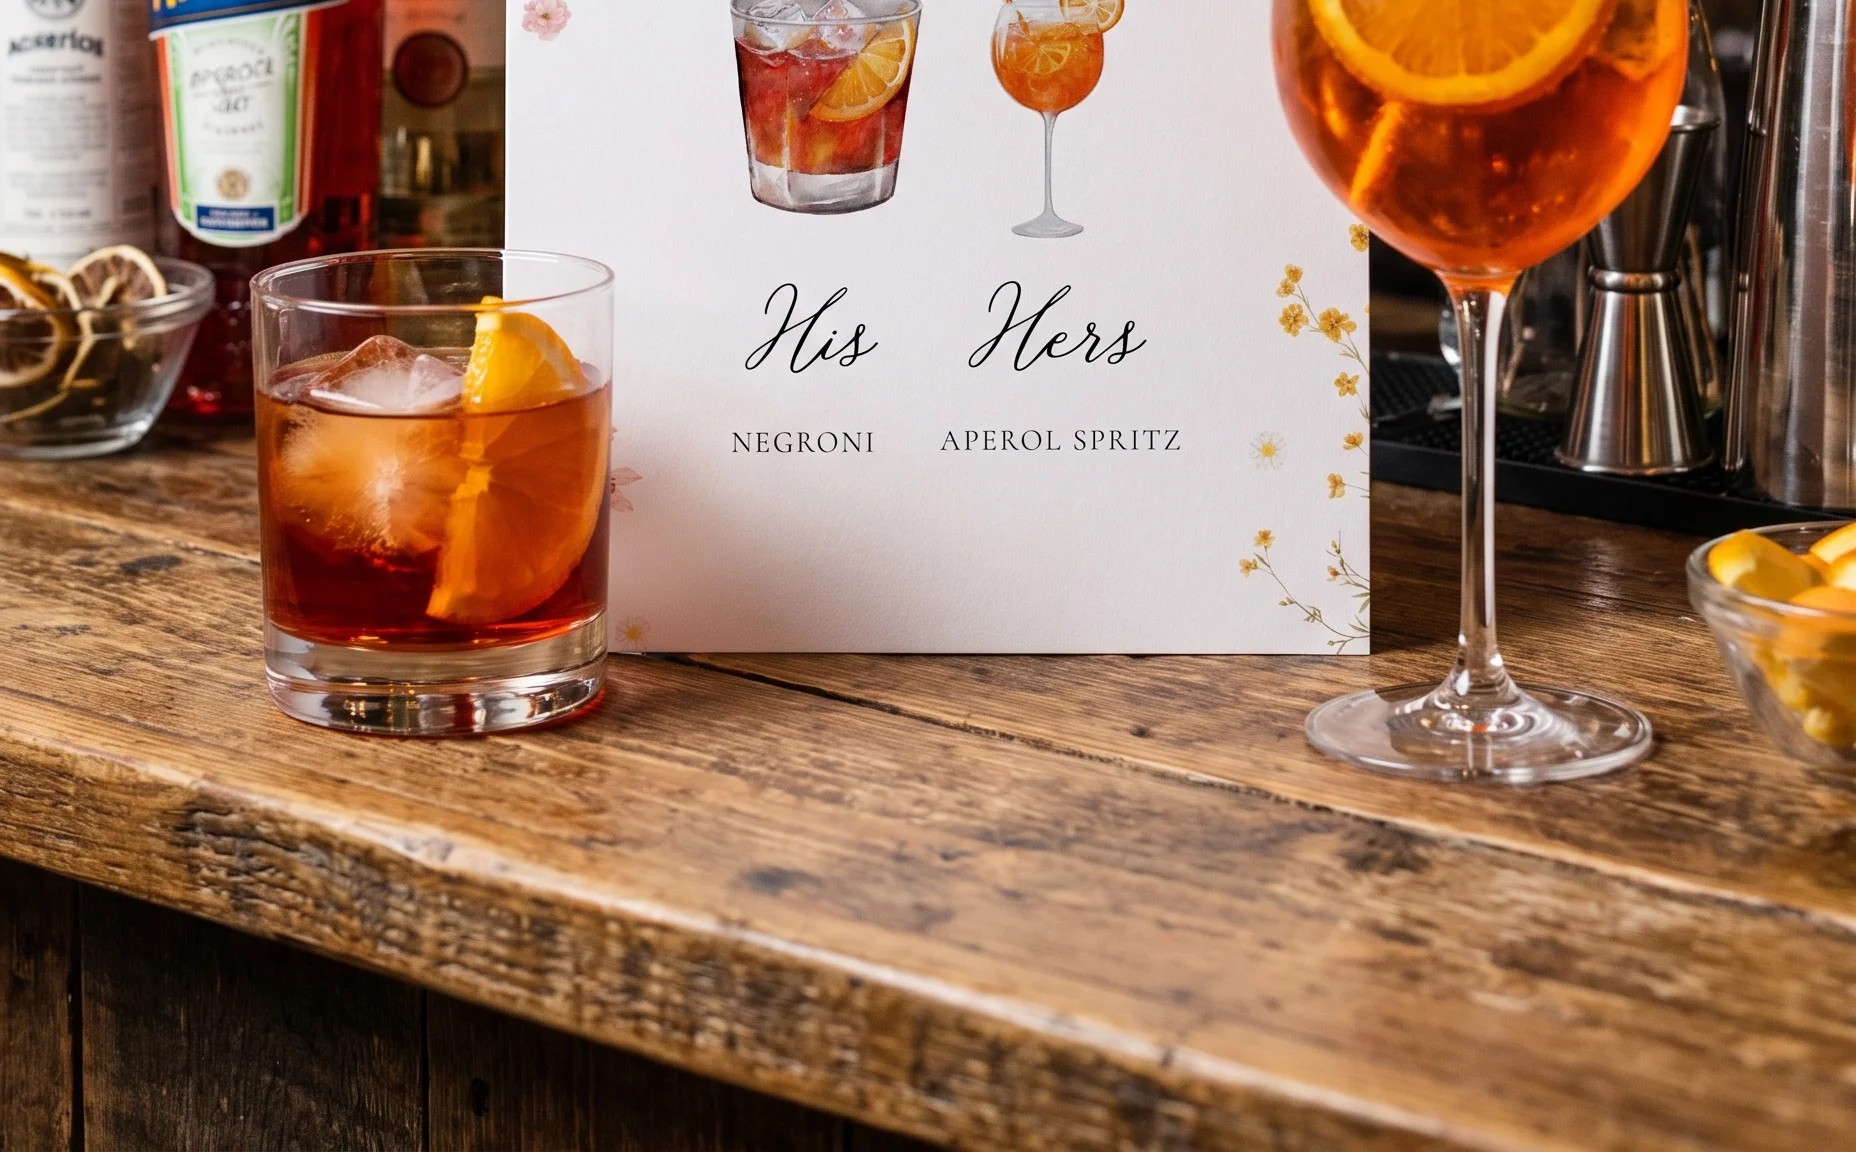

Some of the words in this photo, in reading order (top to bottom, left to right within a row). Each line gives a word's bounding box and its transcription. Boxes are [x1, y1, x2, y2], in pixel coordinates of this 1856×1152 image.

[744, 282, 879, 374] His
[968, 280, 1148, 372] Hers
[732, 431, 873, 453] NEGRONI
[940, 429, 1061, 451] APEROL
[1073, 429, 1181, 451] SPRITZ
